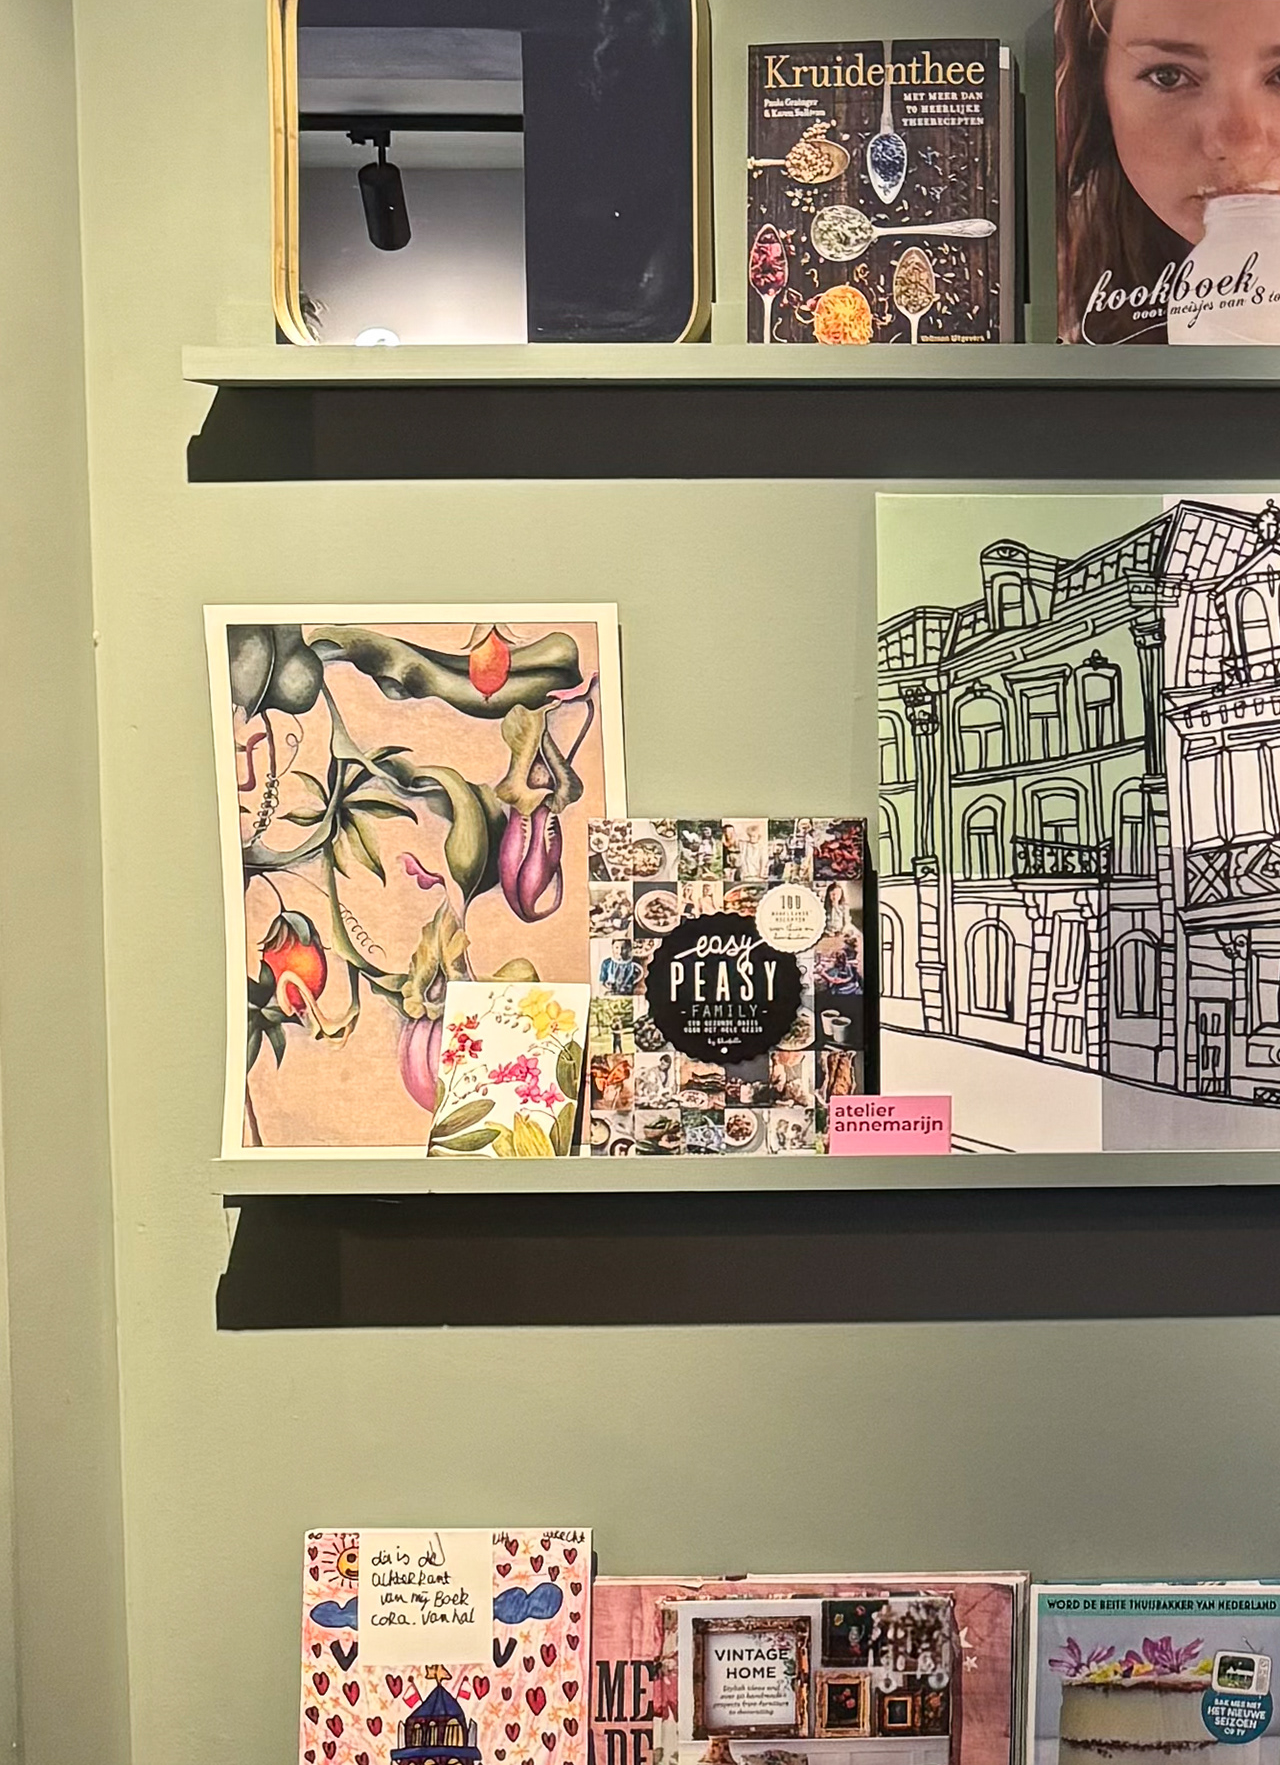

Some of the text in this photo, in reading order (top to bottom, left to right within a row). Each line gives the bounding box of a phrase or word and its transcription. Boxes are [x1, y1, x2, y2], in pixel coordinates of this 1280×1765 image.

[764, 50, 986, 89] Kruidenthee
[903, 92, 926, 102] MET
[960, 91, 984, 101] DAN
[1082, 251, 1259, 316] kookboek
[1169, 299, 1214, 328] meisjes
[1219, 297, 1245, 310] van
[1250, 285, 1266, 305] 8
[673, 934, 767, 972] easy
[669, 960, 777, 1002] PEASY
[691, 1004, 759, 1018] FAMILY
[834, 1102, 896, 1118] atelier
[834, 1116, 944, 1135] annemarijn
[396, 1545, 411, 1566] is
[1047, 1599, 1081, 1610] WORD
[1083, 1599, 1097, 1610] DE
[1196, 1599, 1216, 1611] VAN
[1217, 1599, 1278, 1611] NEDERLAND
[714, 1648, 790, 1662] VINTAGE
[726, 1666, 777, 1680] HOME
[1227, 1707, 1267, 1720] NIEUWE
